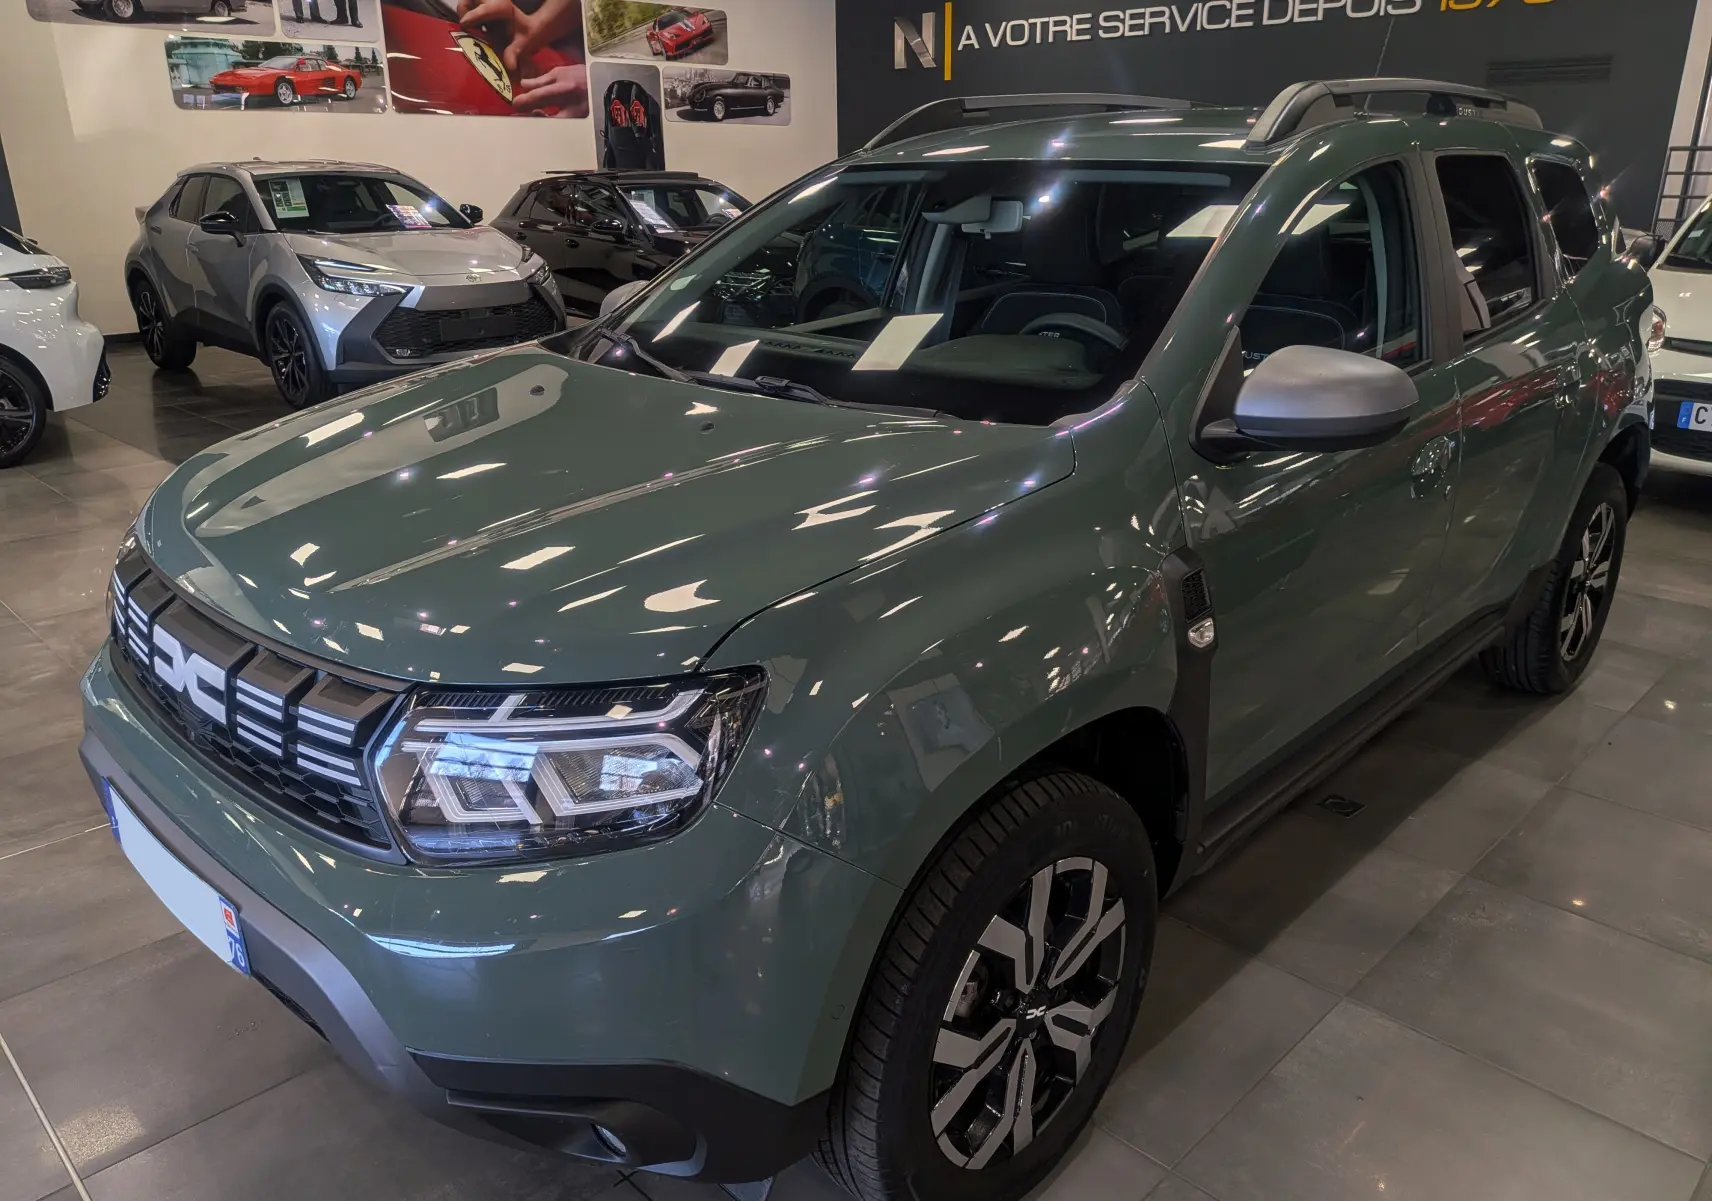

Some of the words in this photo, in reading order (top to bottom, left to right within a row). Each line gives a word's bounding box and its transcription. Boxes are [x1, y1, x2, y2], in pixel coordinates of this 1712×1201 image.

[957, 25, 980, 51] A
[985, 13, 1092, 48] VOTRE
[1098, 0, 1254, 38] SERVICE
